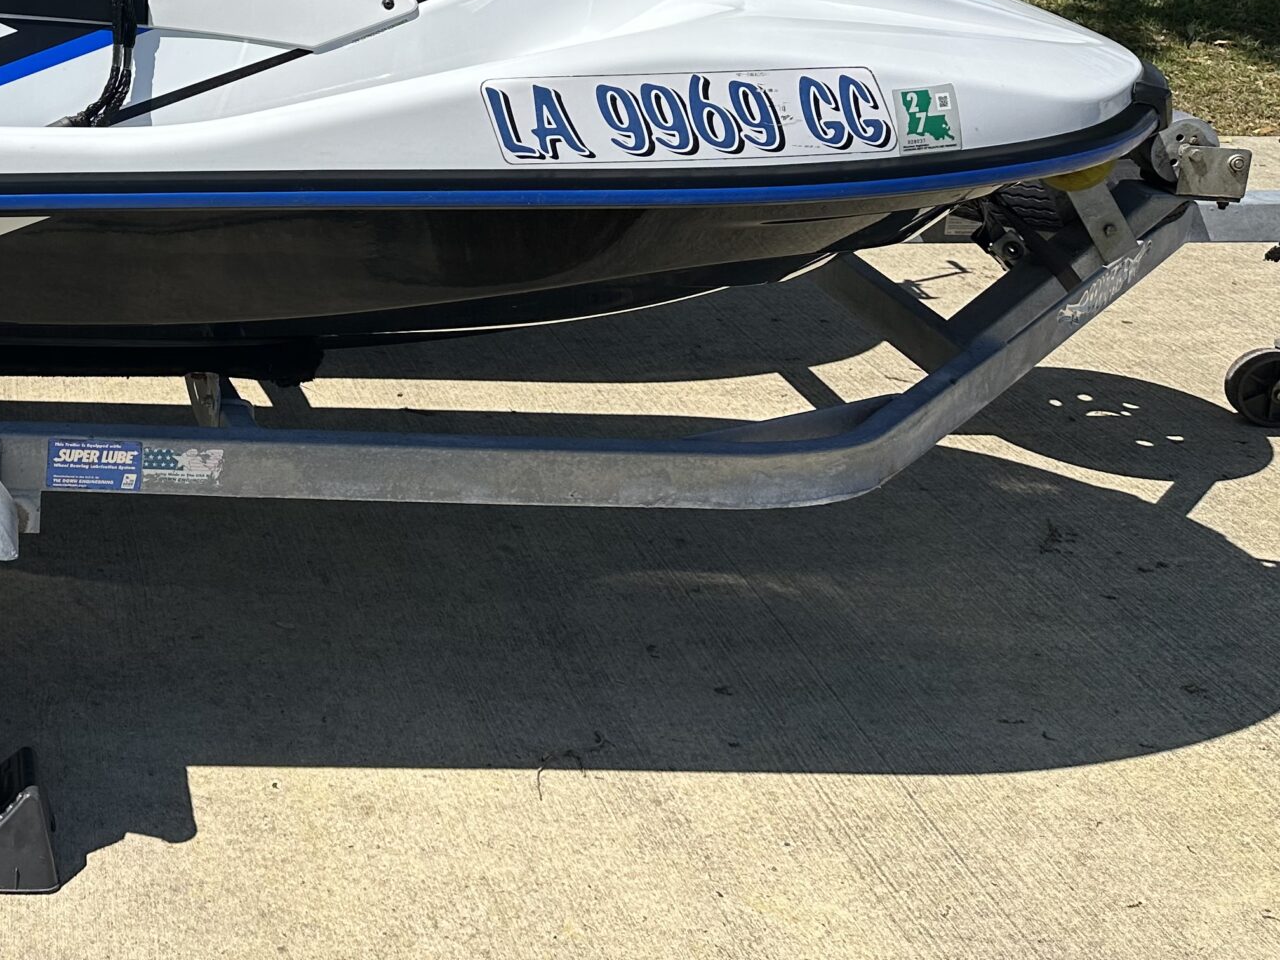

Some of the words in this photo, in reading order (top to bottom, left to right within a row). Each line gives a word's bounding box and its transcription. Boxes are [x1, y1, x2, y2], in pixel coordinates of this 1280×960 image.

[484, 84, 597, 160] LA
[595, 74, 786, 157] 9969
[798, 74, 896, 154] GG
[53, 448, 100, 463] SUPER
[101, 449, 140, 464] LUBE
